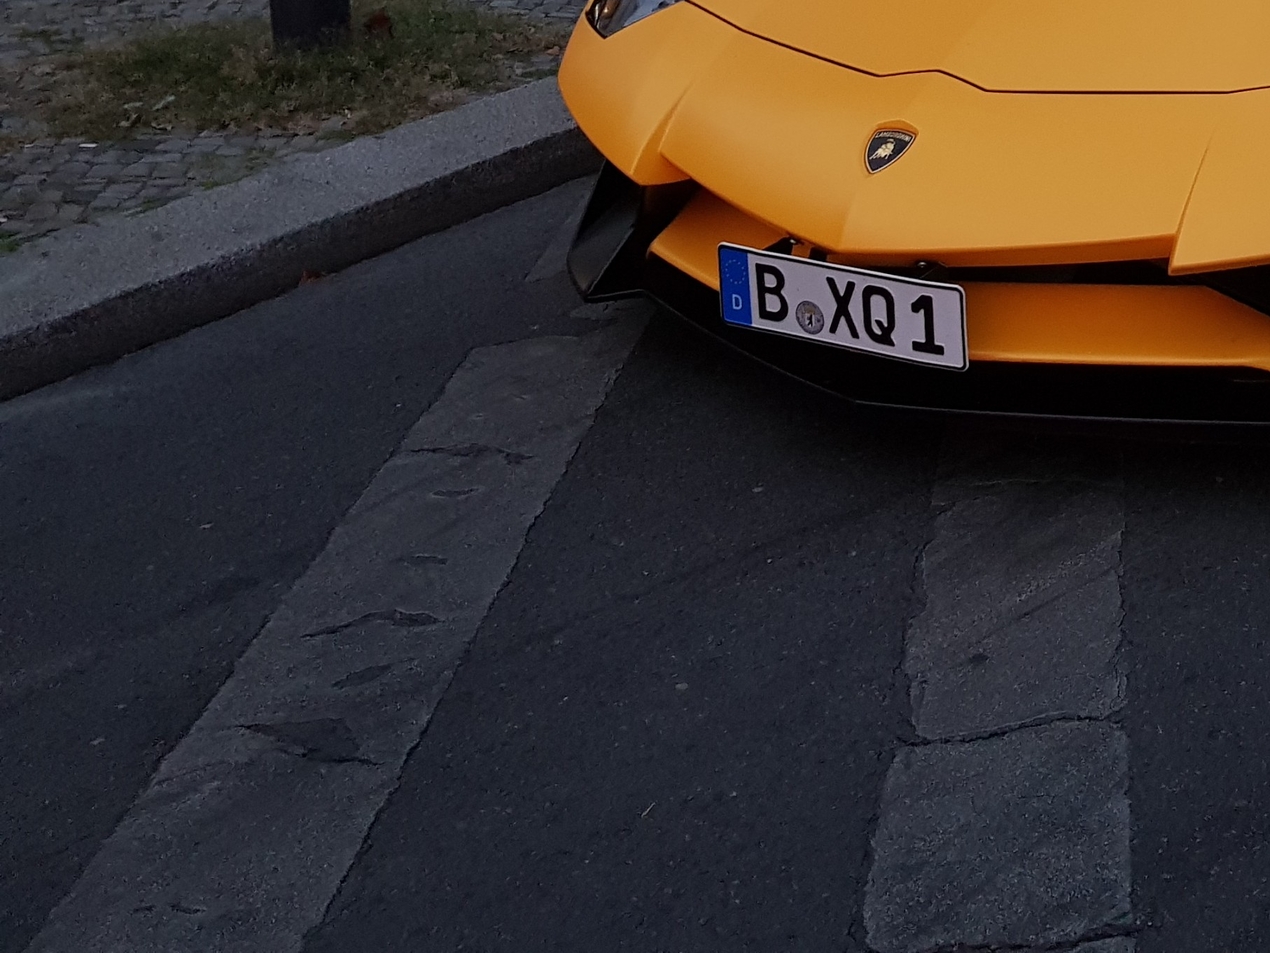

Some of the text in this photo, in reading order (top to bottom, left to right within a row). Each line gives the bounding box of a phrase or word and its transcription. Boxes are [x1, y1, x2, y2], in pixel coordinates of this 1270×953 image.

[732, 294, 743, 311] D
[755, 263, 945, 357] B XQ 1
